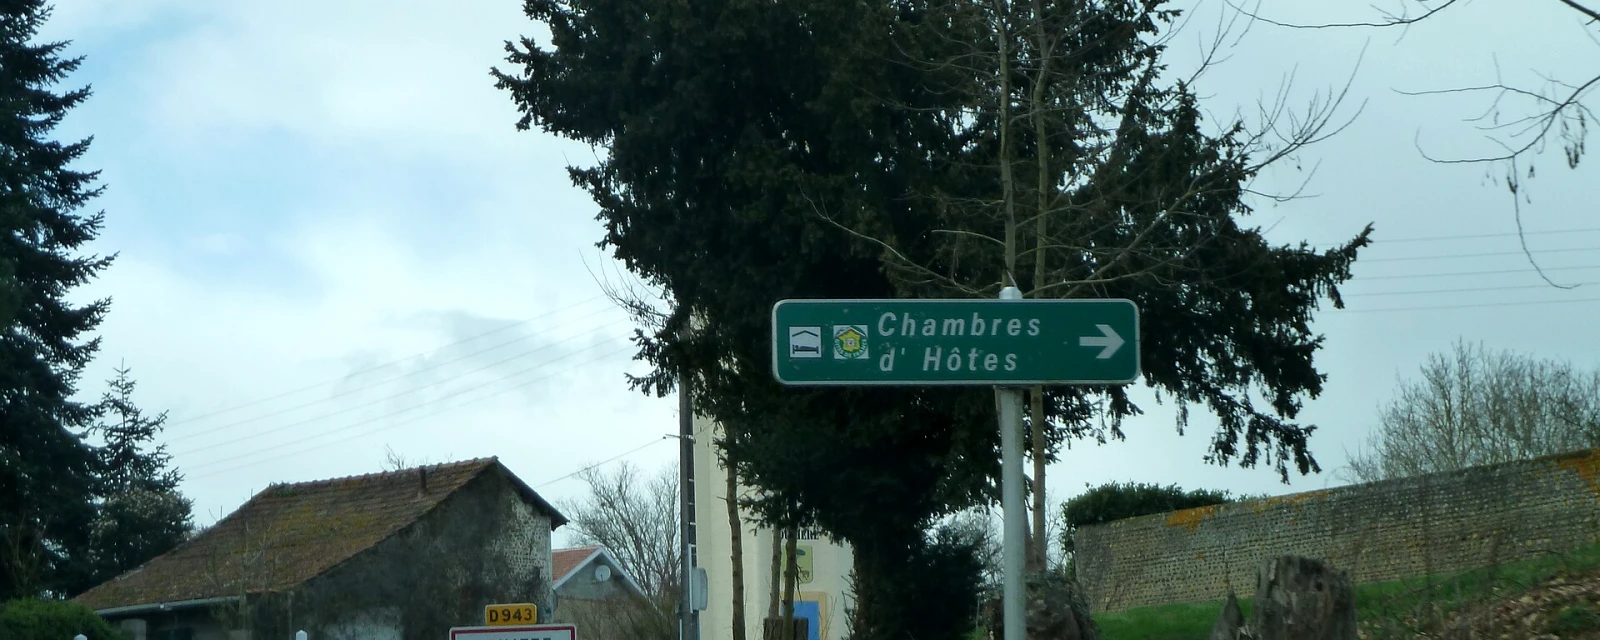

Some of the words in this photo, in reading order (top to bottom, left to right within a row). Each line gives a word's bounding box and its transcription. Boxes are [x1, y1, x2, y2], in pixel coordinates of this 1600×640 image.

[877, 312, 1041, 337] Chambres
[879, 347, 906, 372] d'
[923, 347, 1018, 372] Hôtes
[489, 608, 533, 622] D943
